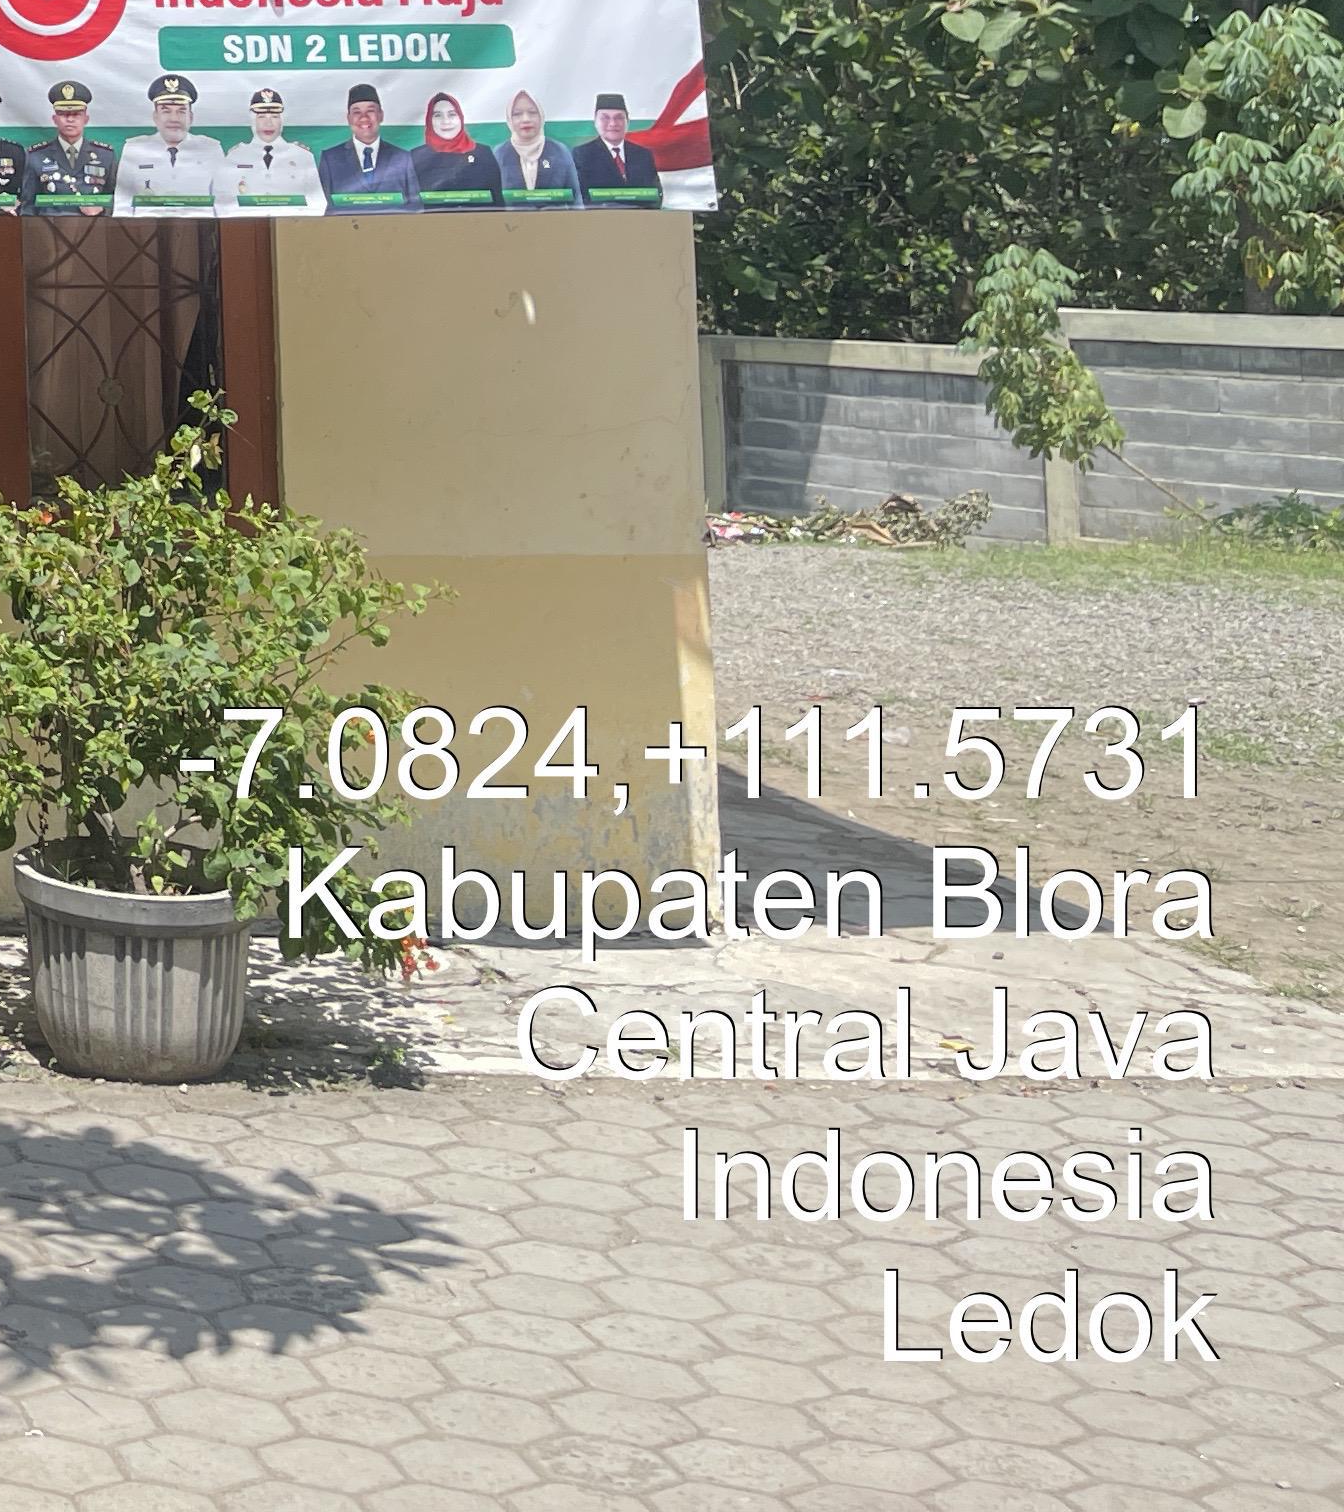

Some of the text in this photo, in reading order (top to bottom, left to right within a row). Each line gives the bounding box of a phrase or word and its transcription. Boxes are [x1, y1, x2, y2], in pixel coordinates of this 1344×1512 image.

[223, 32, 453, 64] SDN 2 LEDOK
